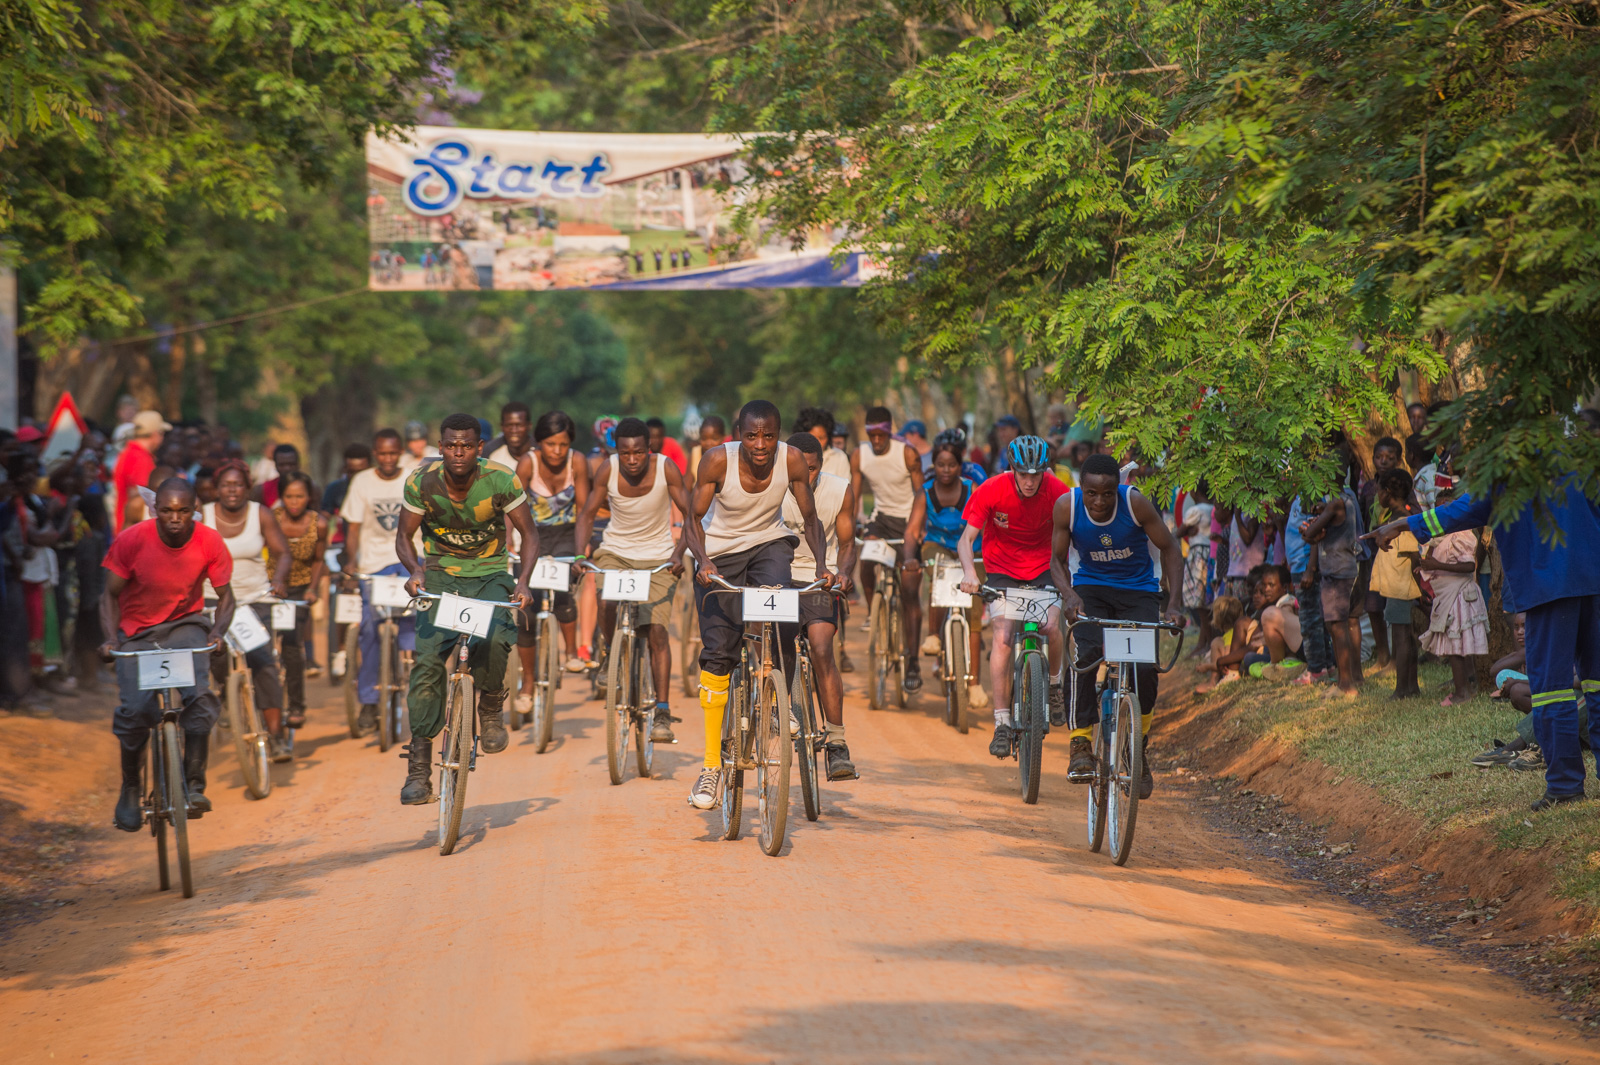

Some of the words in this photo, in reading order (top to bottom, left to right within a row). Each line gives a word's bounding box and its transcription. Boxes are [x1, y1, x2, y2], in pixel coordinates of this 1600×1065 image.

[408, 142, 606, 210] Start
[1088, 546, 1133, 562] BRASIL
[540, 564, 559, 580] 12
[388, 584, 398, 597] 7
[617, 578, 636, 593] 13
[763, 594, 777, 610] 4
[1015, 597, 1036, 613] 26
[459, 606, 473, 624] 6
[234, 621, 254, 640] 60
[1124, 637, 1133, 655] 1
[160, 660, 171, 679] 5
